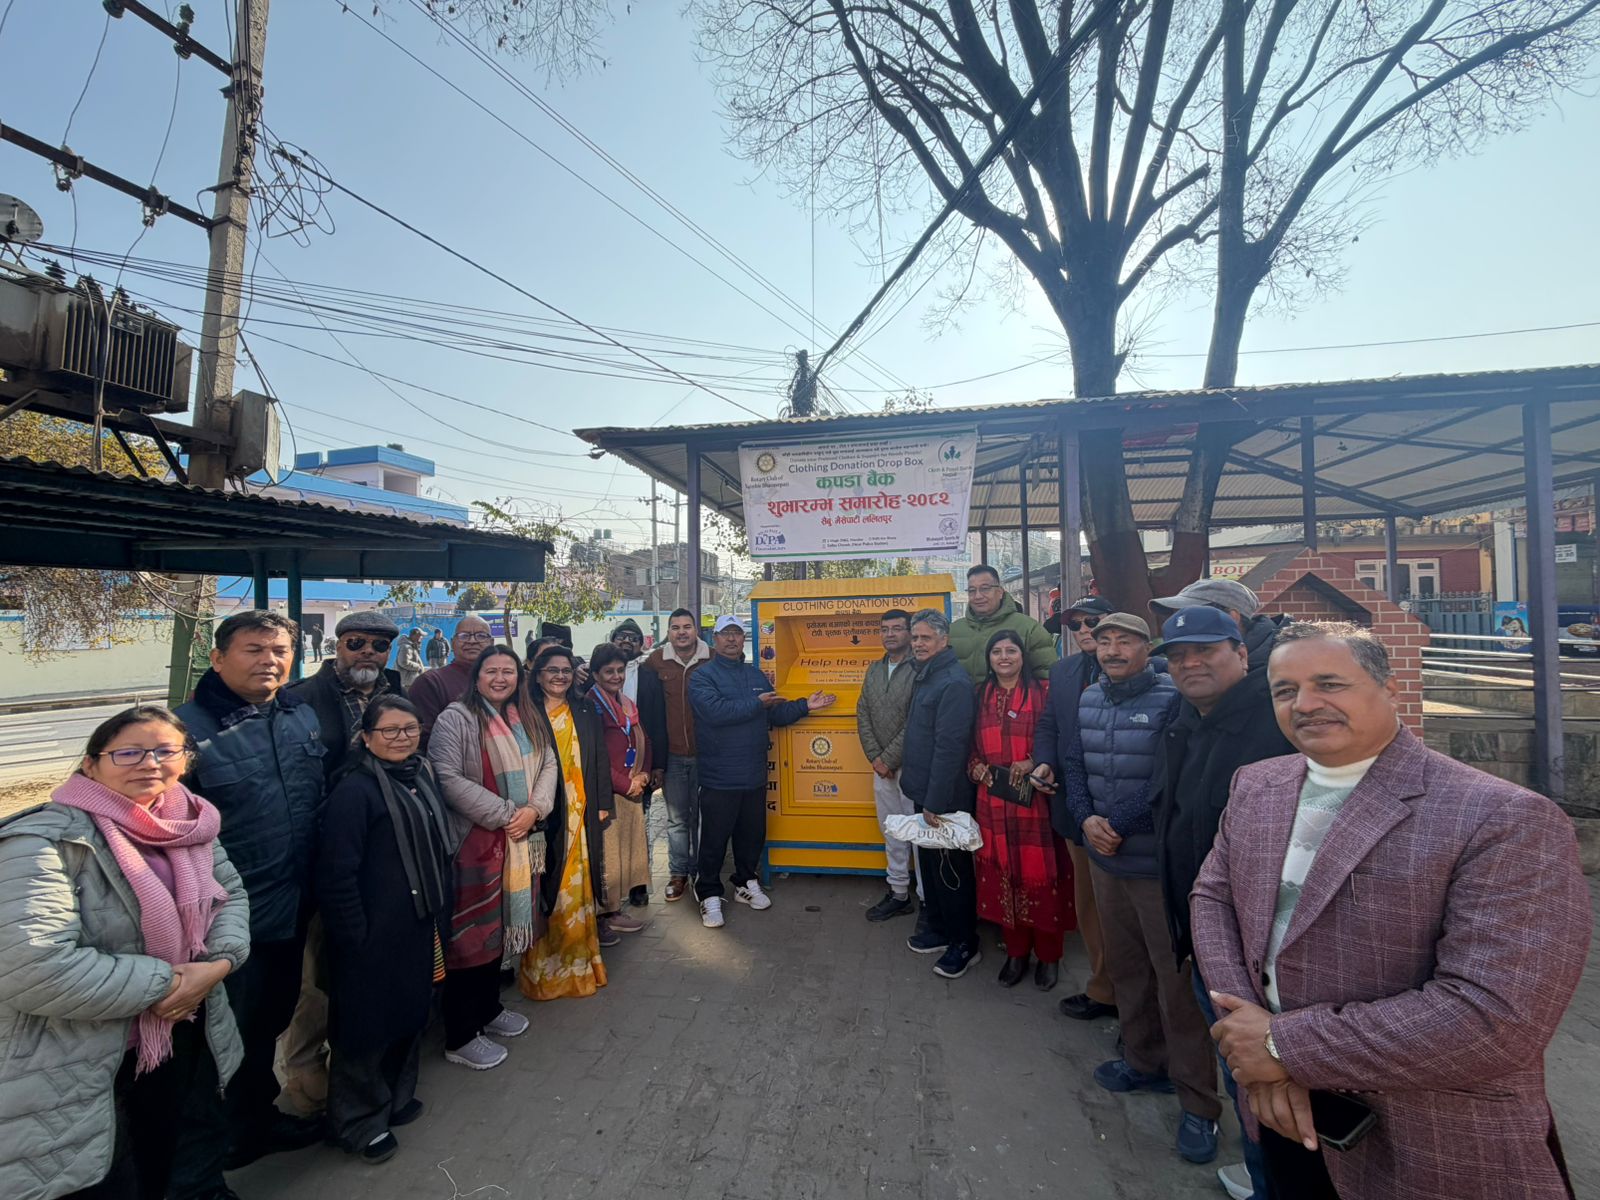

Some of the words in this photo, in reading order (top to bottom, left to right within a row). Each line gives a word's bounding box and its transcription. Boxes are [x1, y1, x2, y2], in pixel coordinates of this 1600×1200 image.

[788, 461, 829, 474] Clothing
[830, 460, 876, 472] Donation
[877, 458, 903, 468] Drop
[904, 456, 924, 466] Box
[816, 474, 862, 489] कपडा
[767, 497, 834, 518] शुभारम्भ
[783, 600, 834, 612] CLOTHING
[836, 598, 890, 610] DONATION
[892, 597, 915, 607] BOX
[801, 658, 832, 668] Help
[837, 658, 858, 666] the
